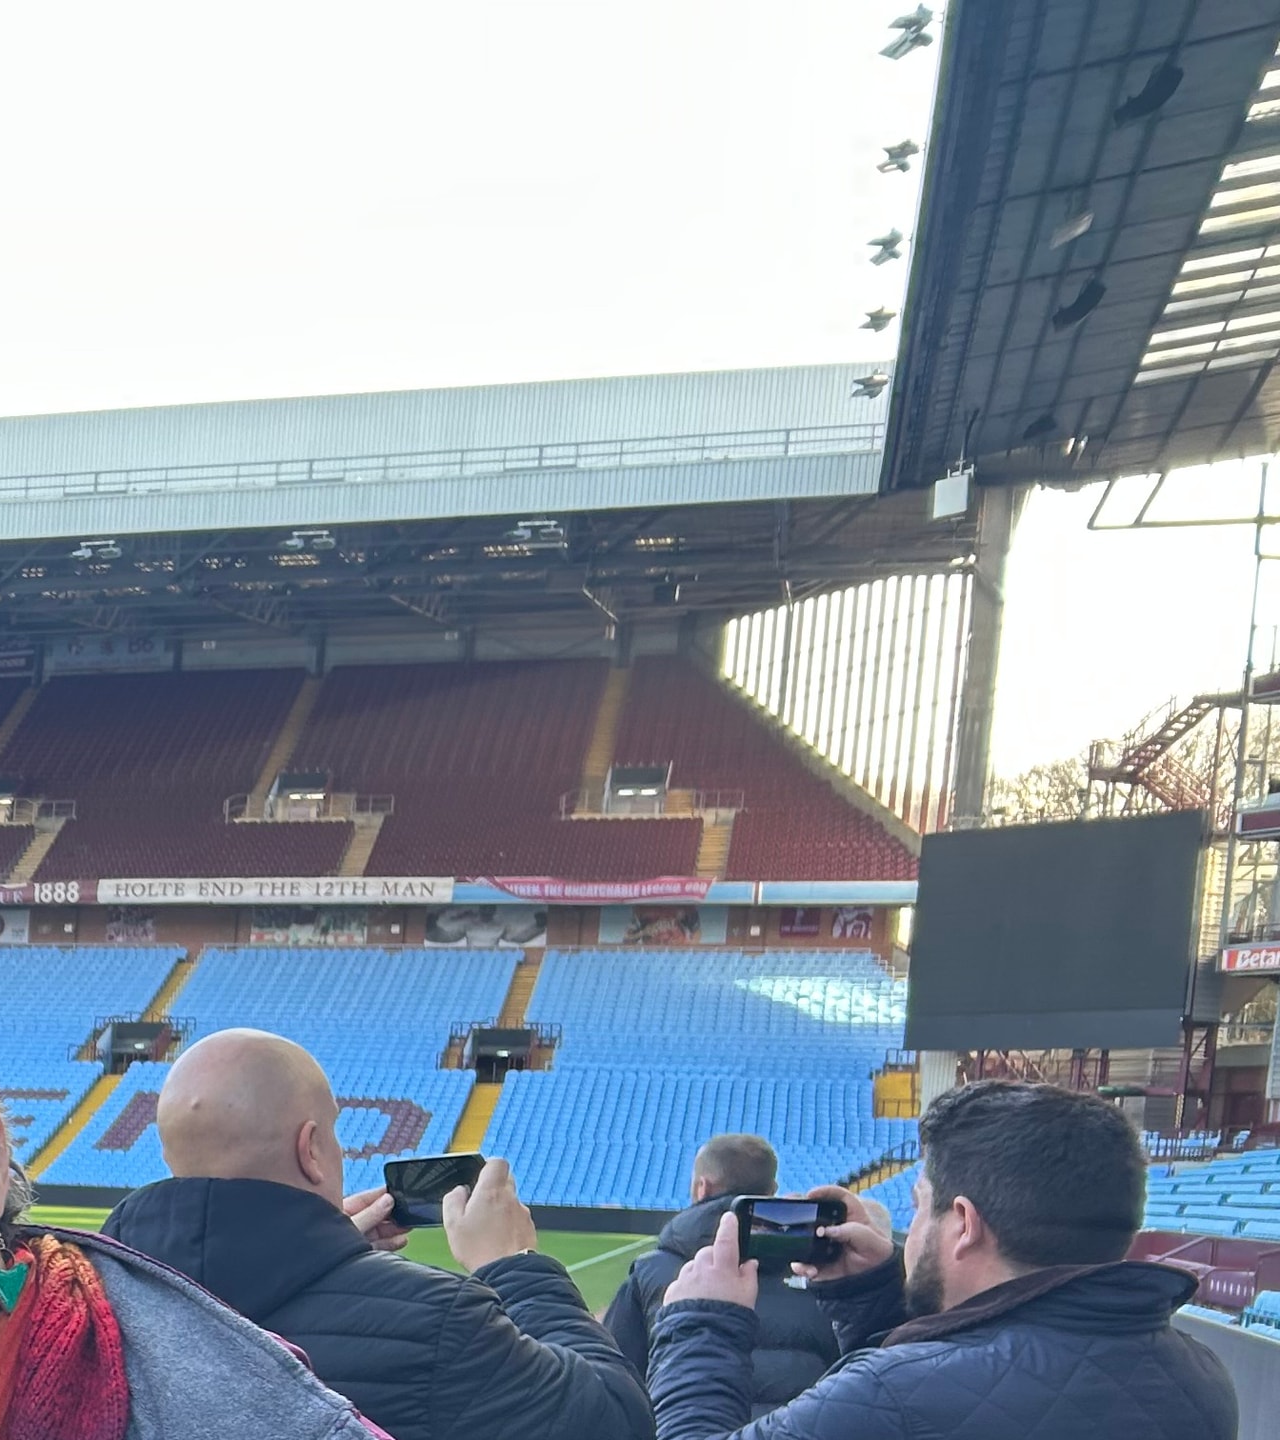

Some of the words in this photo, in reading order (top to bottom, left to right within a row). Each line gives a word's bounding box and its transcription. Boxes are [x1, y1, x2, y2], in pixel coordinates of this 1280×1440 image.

[33, 881, 80, 904] 1888
[114, 882, 185, 898] HOLTE
[198, 882, 244, 898] END
[255, 882, 301, 897] THE
[313, 882, 368, 897] 12TH
[381, 882, 435, 898] MAN
